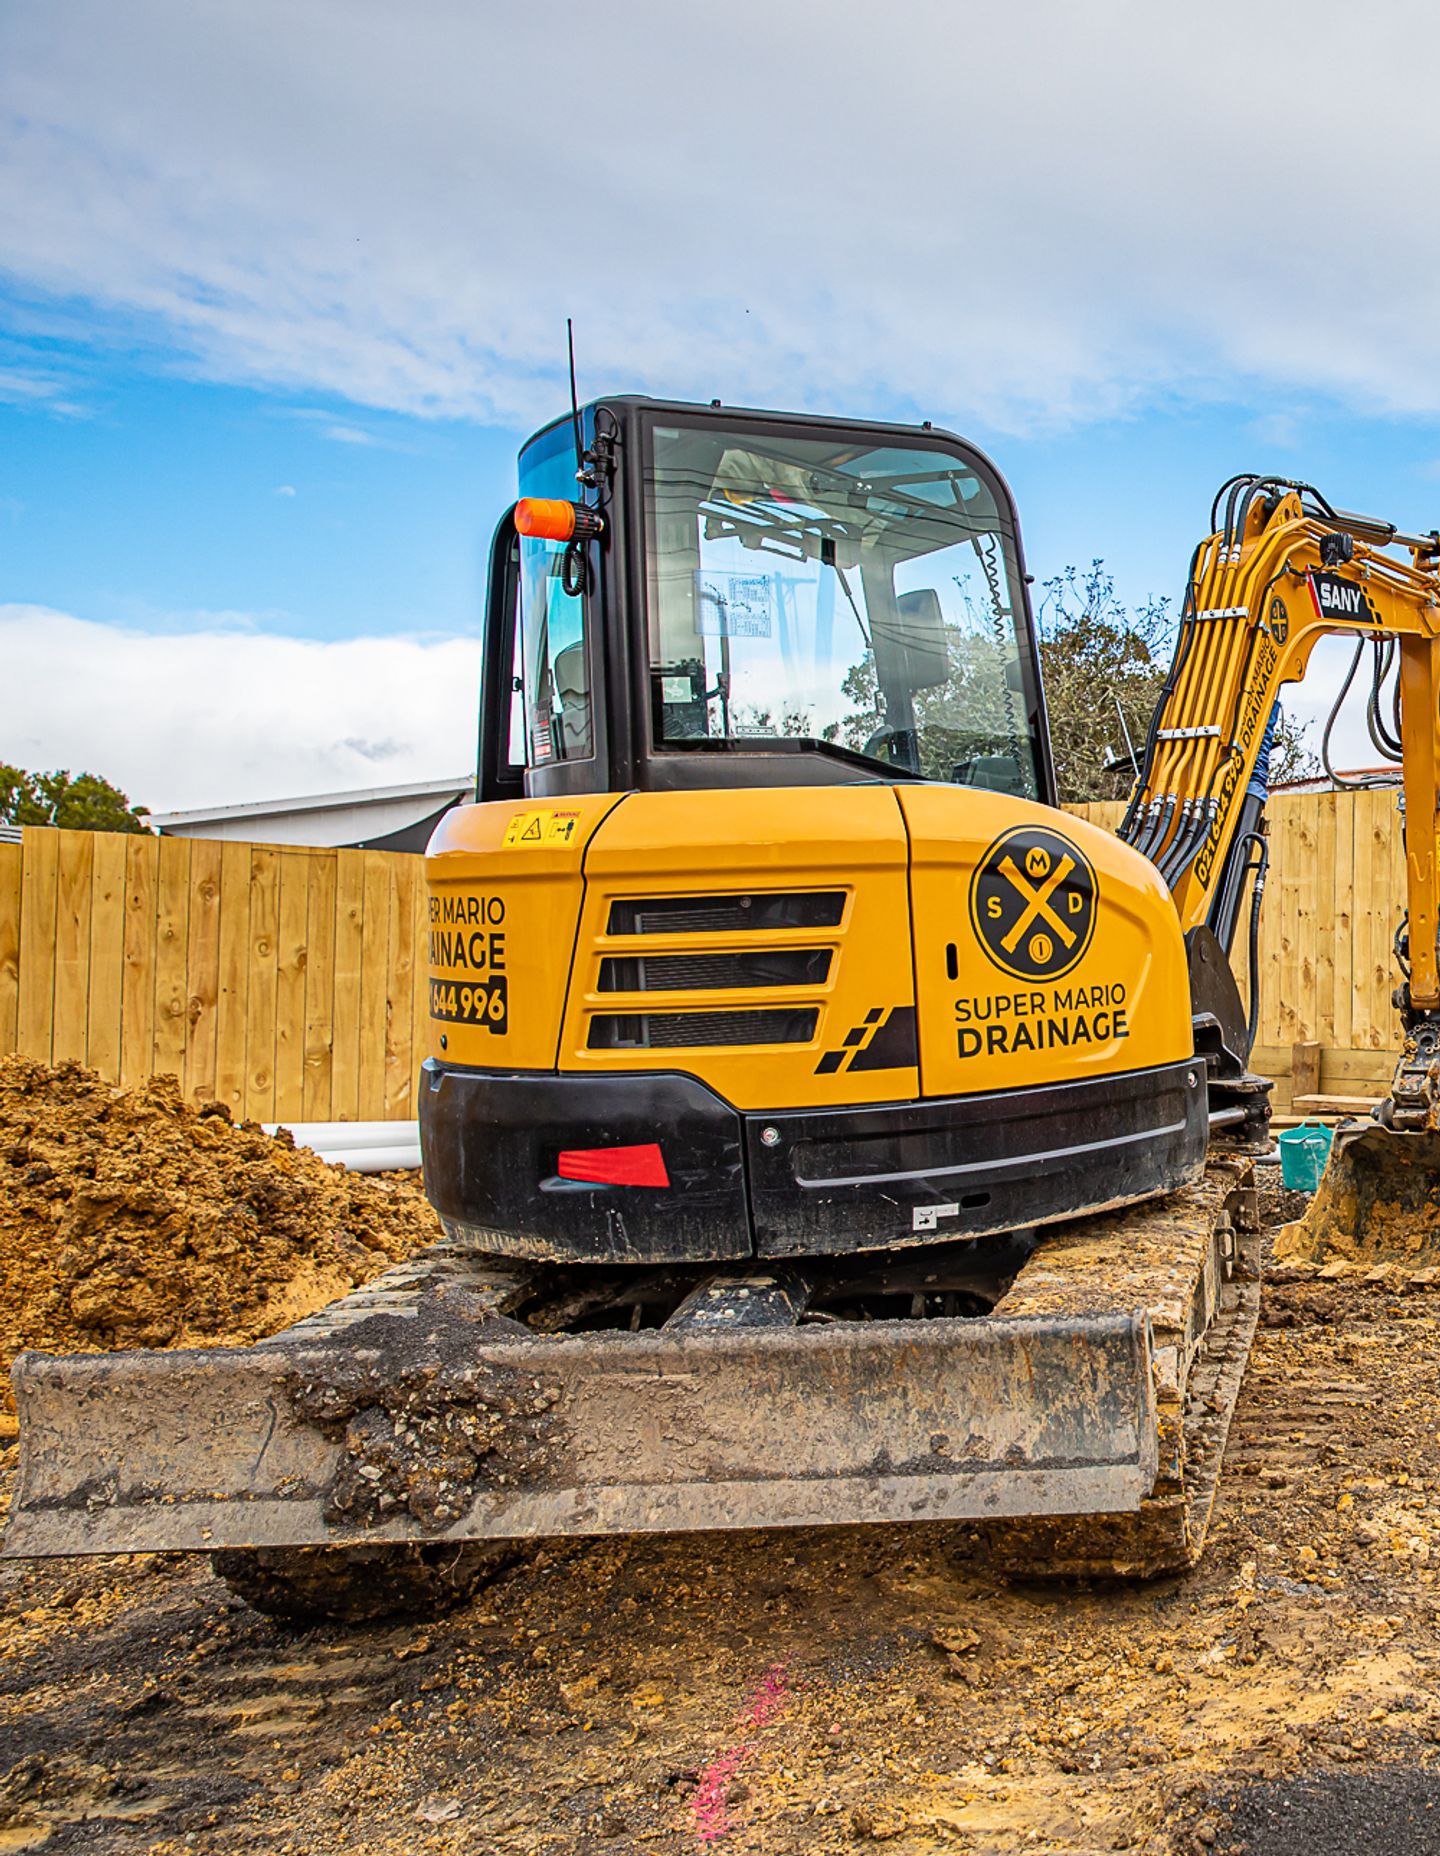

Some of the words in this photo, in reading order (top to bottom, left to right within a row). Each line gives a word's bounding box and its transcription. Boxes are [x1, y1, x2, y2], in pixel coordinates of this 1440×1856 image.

[1320, 582, 1361, 613] SANY
[1242, 645, 1277, 748] DRAINAGE
[1029, 853, 1047, 871] M
[1198, 836, 1215, 882] 021
[443, 896, 505, 925] MARIO
[987, 896, 1002, 919] S
[1068, 892, 1083, 914] D
[429, 931, 506, 970] AINAGE
[433, 984, 457, 1017] 644
[460, 987, 505, 1021] 996
[954, 991, 1046, 1022] SUPER
[1053, 983, 1126, 1012] MARIO
[957, 1009, 1130, 1059] DRAINAGE
